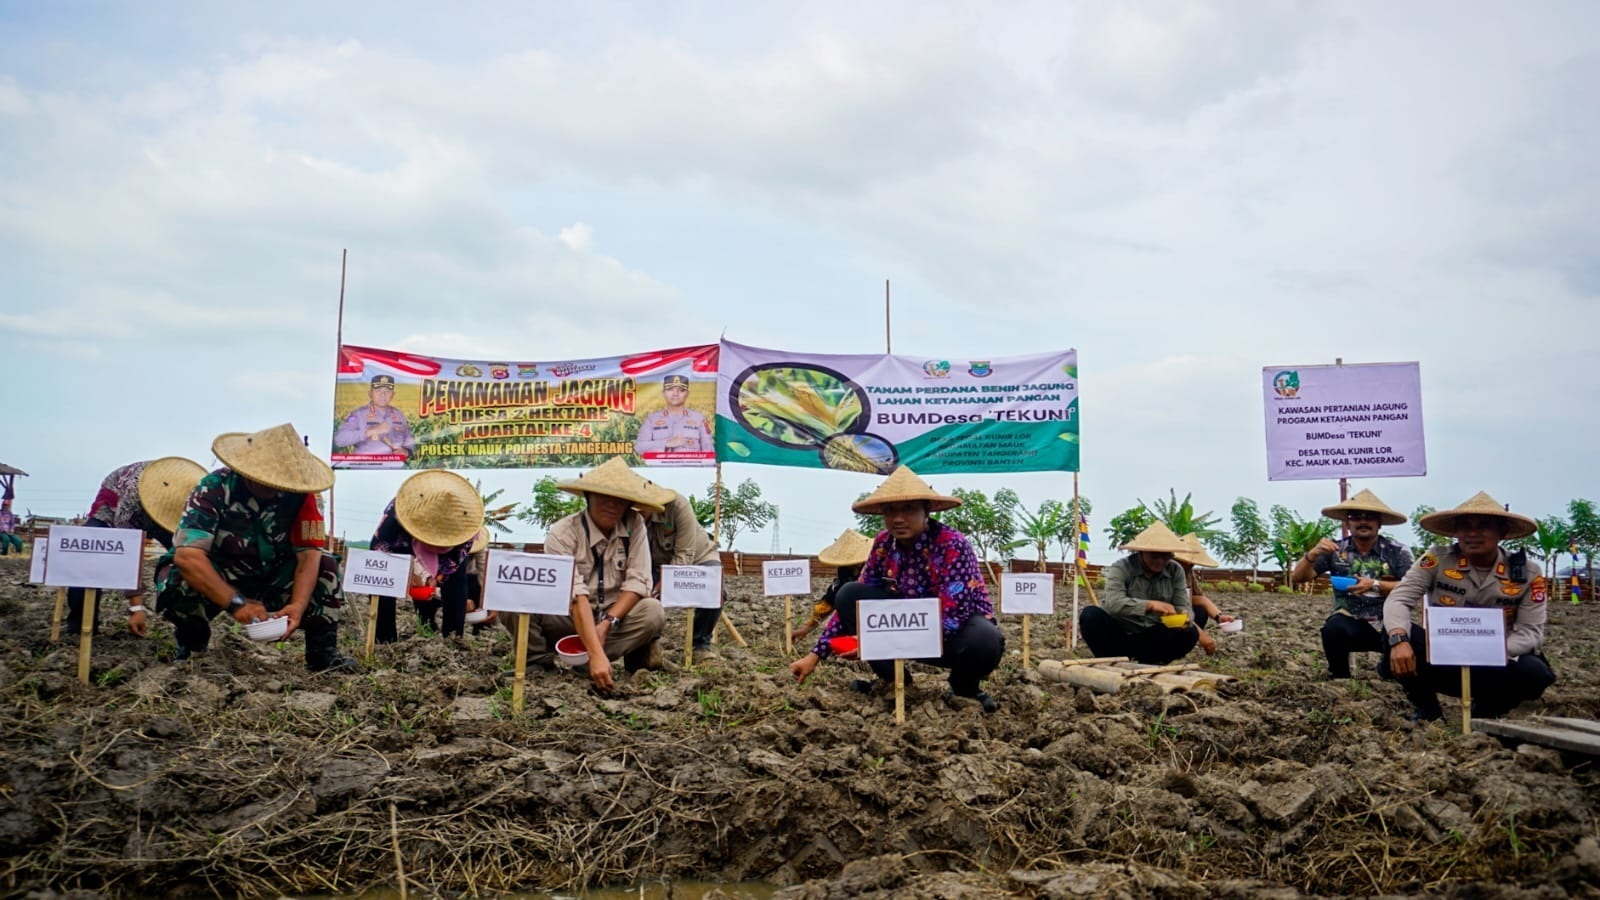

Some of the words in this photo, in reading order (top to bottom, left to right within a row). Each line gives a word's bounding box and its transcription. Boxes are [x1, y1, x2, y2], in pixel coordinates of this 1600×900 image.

[866, 385, 912, 394] TANAM
[916, 385, 978, 394] PERDANA
[1022, 383, 1074, 392] JAGUNG
[419, 379, 549, 417] PENANAMAN
[553, 377, 636, 415] JAGUNG
[877, 396, 921, 405] LAHAN
[925, 396, 1003, 405] KETAHANAN
[1007, 394, 1060, 403] PANGAN
[1278, 406, 1322, 414] KAWASAN
[1323, 404, 1370, 413] PERTANIAN
[1372, 402, 1408, 411] JAGUNG
[448, 408, 459, 425] 1
[461, 408, 509, 424] DESA
[511, 408, 525, 422] 2
[528, 406, 609, 421] HEKTARE
[877, 411, 984, 425] BUMDesa
[1277, 416, 1319, 424] PROGRAM
[1320, 415, 1371, 423] KETAHANAN
[1372, 413, 1408, 421] PANGAN
[463, 422, 547, 439] KUARTAL
[1306, 432, 1345, 440] BUMDesa
[420, 443, 466, 456] POLSEK
[467, 443, 503, 455] MAUK
[505, 442, 563, 455] POLRESTA
[564, 441, 634, 454] TANGERANG
[1298, 449, 1320, 457] DESA
[1321, 448, 1346, 456] TEGAL
[1347, 447, 1374, 455] KUNIR
[1375, 446, 1392, 454] LOR
[1285, 459, 1304, 467] KEC.
[1305, 458, 1331, 467] MAUK
[1332, 457, 1352, 466] KAB.
[1353, 456, 1405, 465] TANGERANG
[60, 538, 125, 553] BABINSA
[364, 558, 388, 569] KASI
[497, 564, 557, 584] KADES
[768, 567, 803, 577] KET.BPD
[353, 574, 394, 587] BINWAS
[1015, 582, 1037, 593] BPP
[867, 612, 929, 629] CAMAT
[1450, 616, 1481, 624] KAPOLSEK
